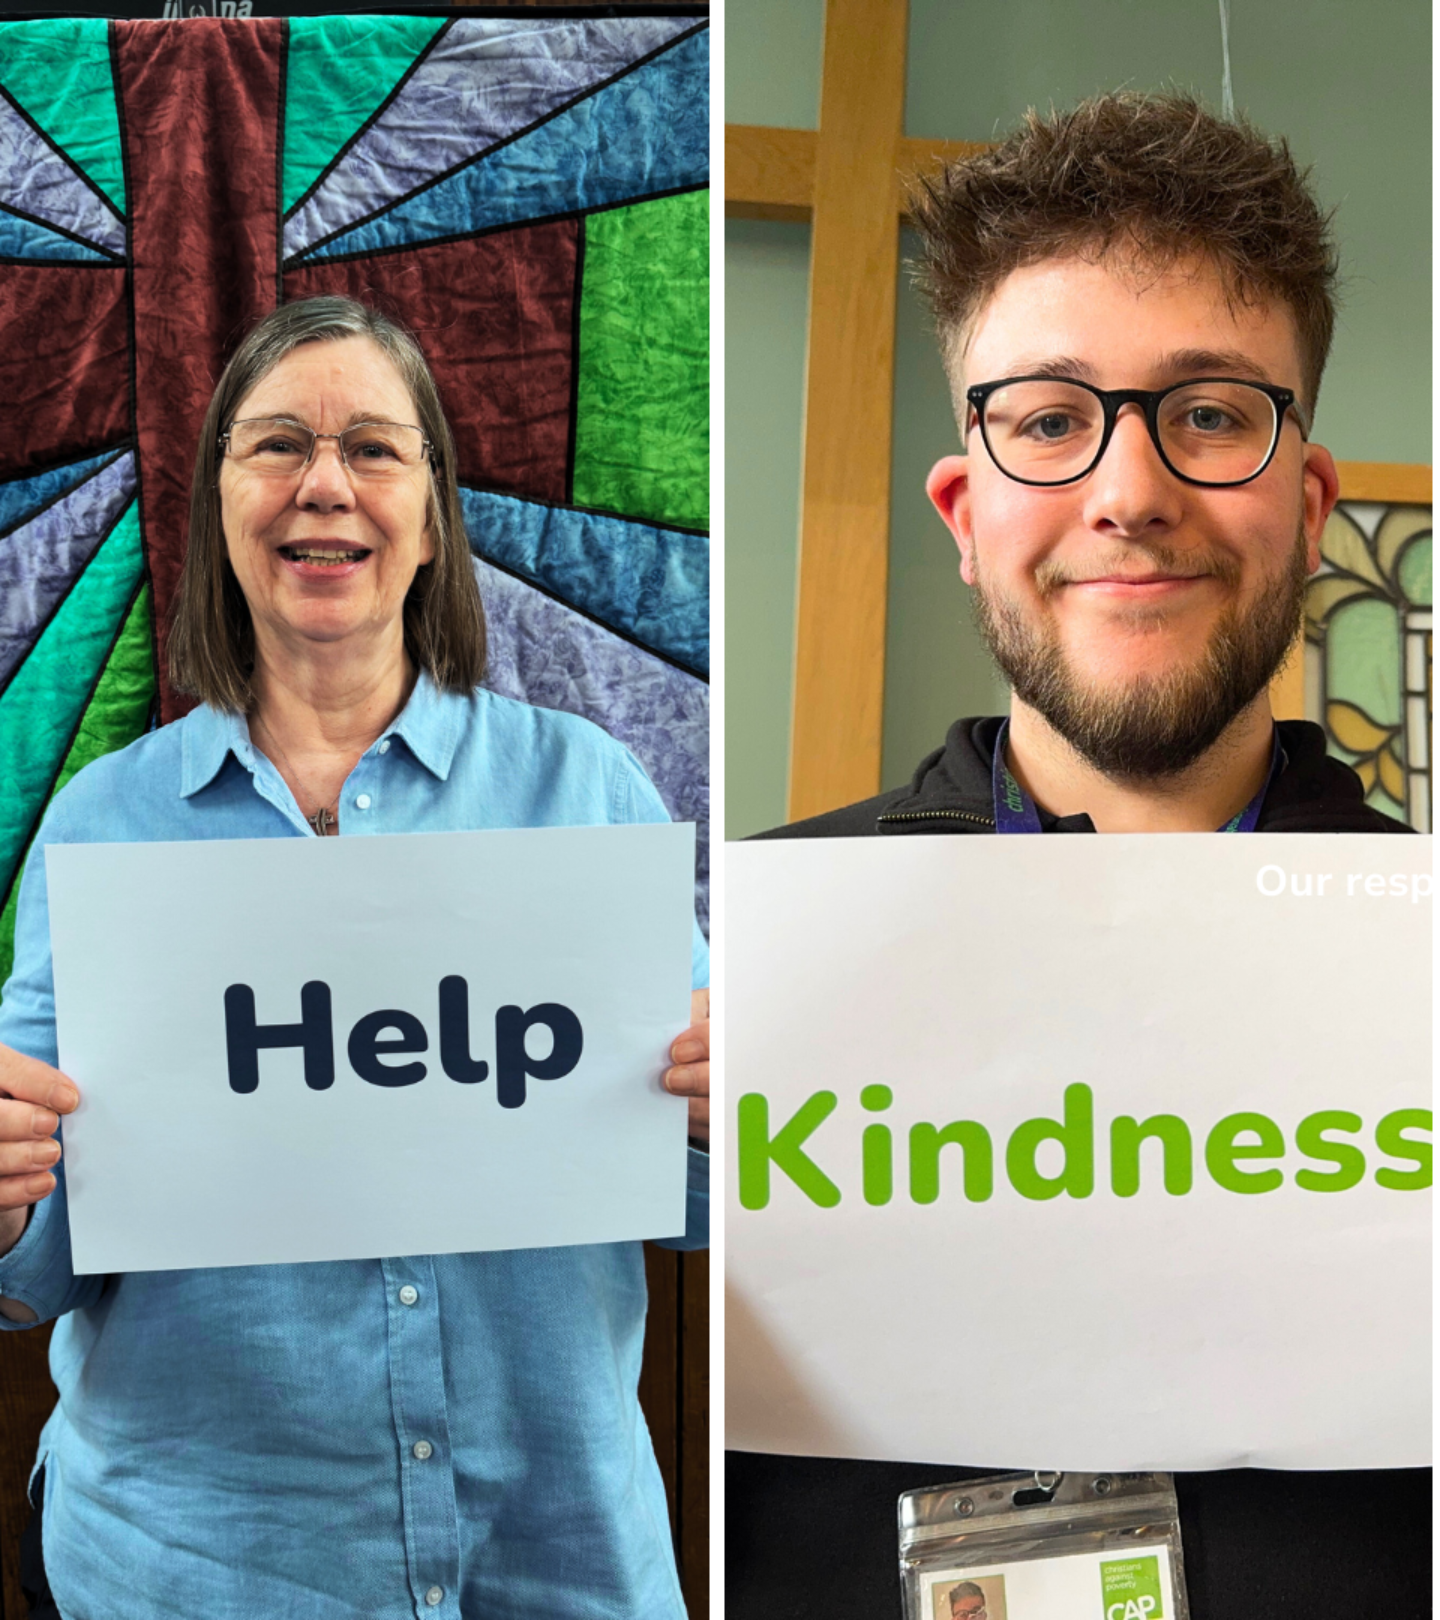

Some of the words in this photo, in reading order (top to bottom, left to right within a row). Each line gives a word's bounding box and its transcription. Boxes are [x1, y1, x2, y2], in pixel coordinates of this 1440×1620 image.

[223, 974, 585, 1110] Help
[737, 1082, 1433, 1211] Kindness
[1106, 1581, 1137, 1592] poverty
